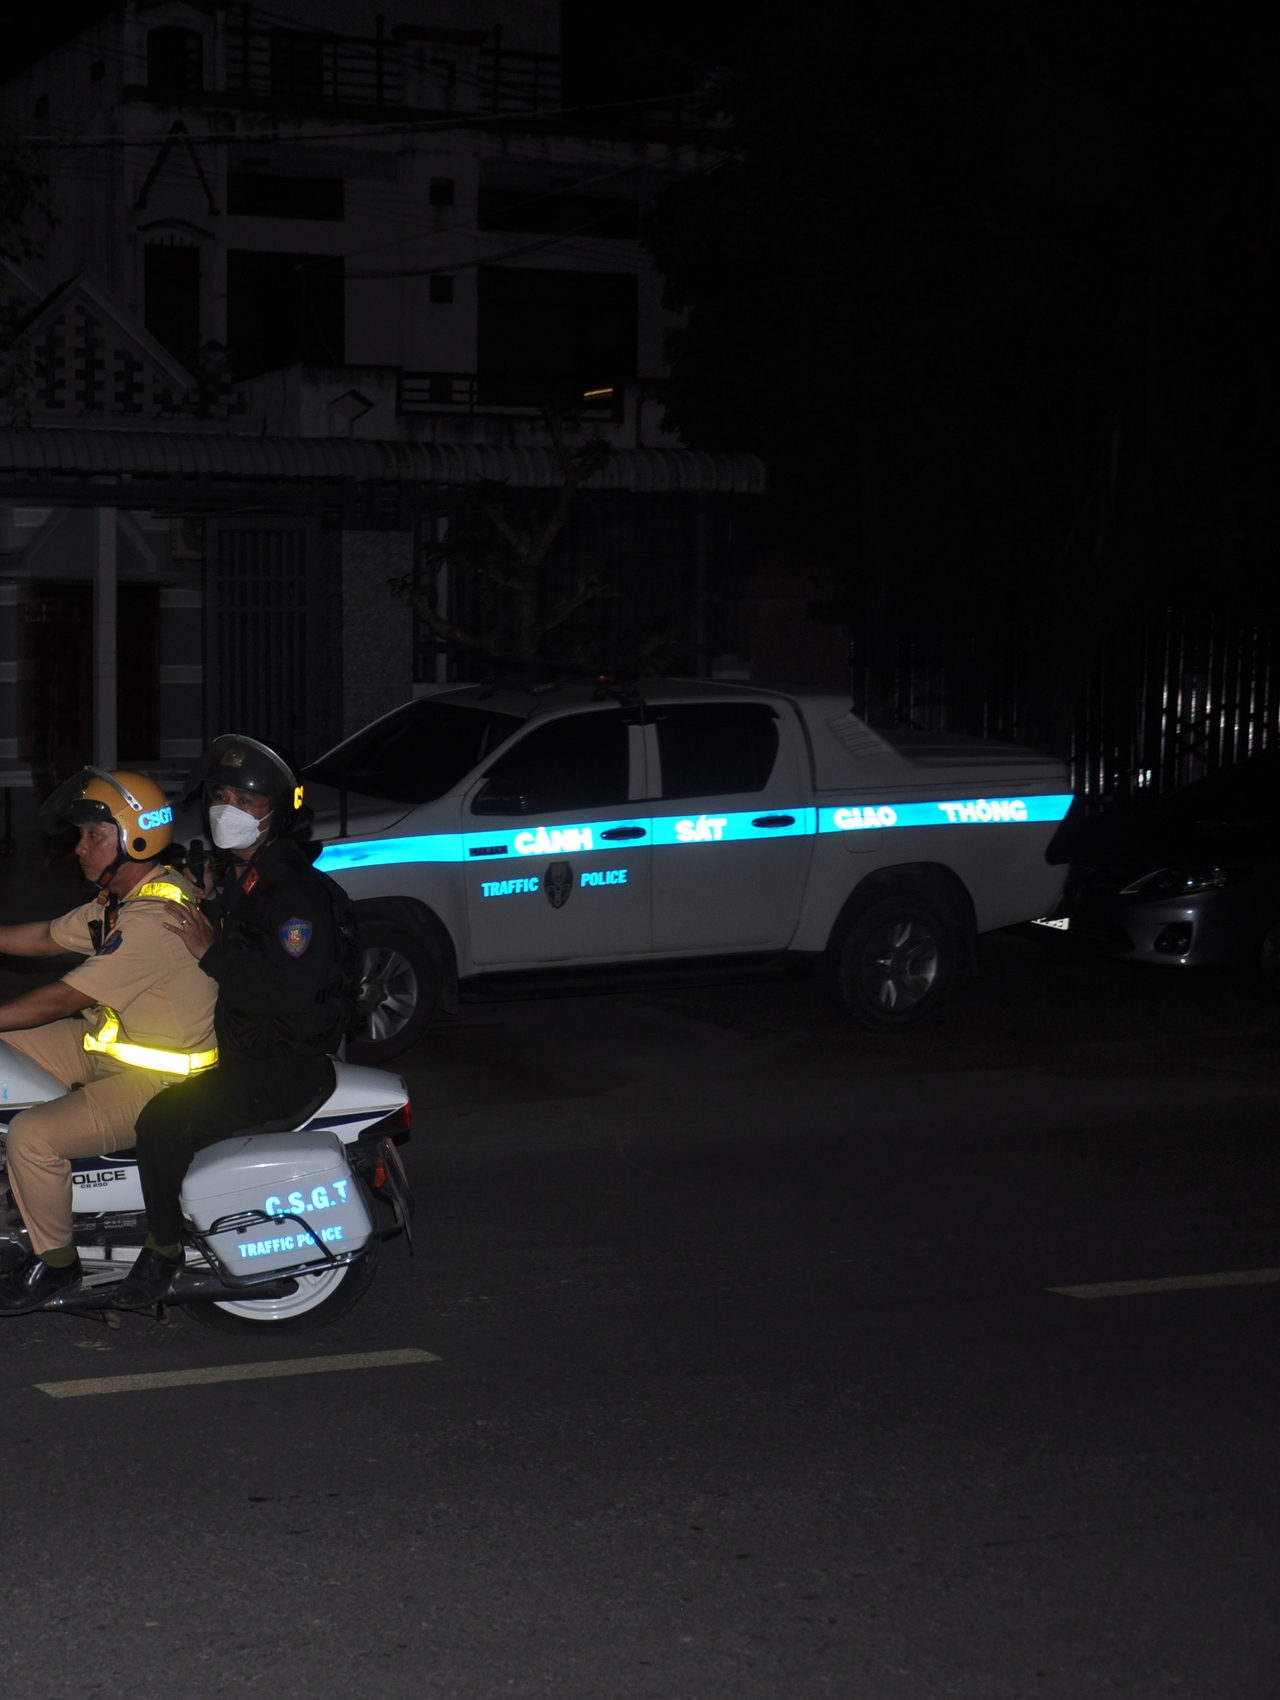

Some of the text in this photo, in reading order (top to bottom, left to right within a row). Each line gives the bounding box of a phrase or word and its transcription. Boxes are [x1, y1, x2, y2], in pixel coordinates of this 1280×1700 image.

[675, 814, 728, 842] SÁT
[833, 805, 898, 831] GIAO
[938, 799, 1028, 823] THÔNG
[481, 868, 628, 898] TRAFFIC POLICE
[72, 1169, 126, 1185] OLICE
[238, 1226, 343, 1258] TRAFFIC POICE
